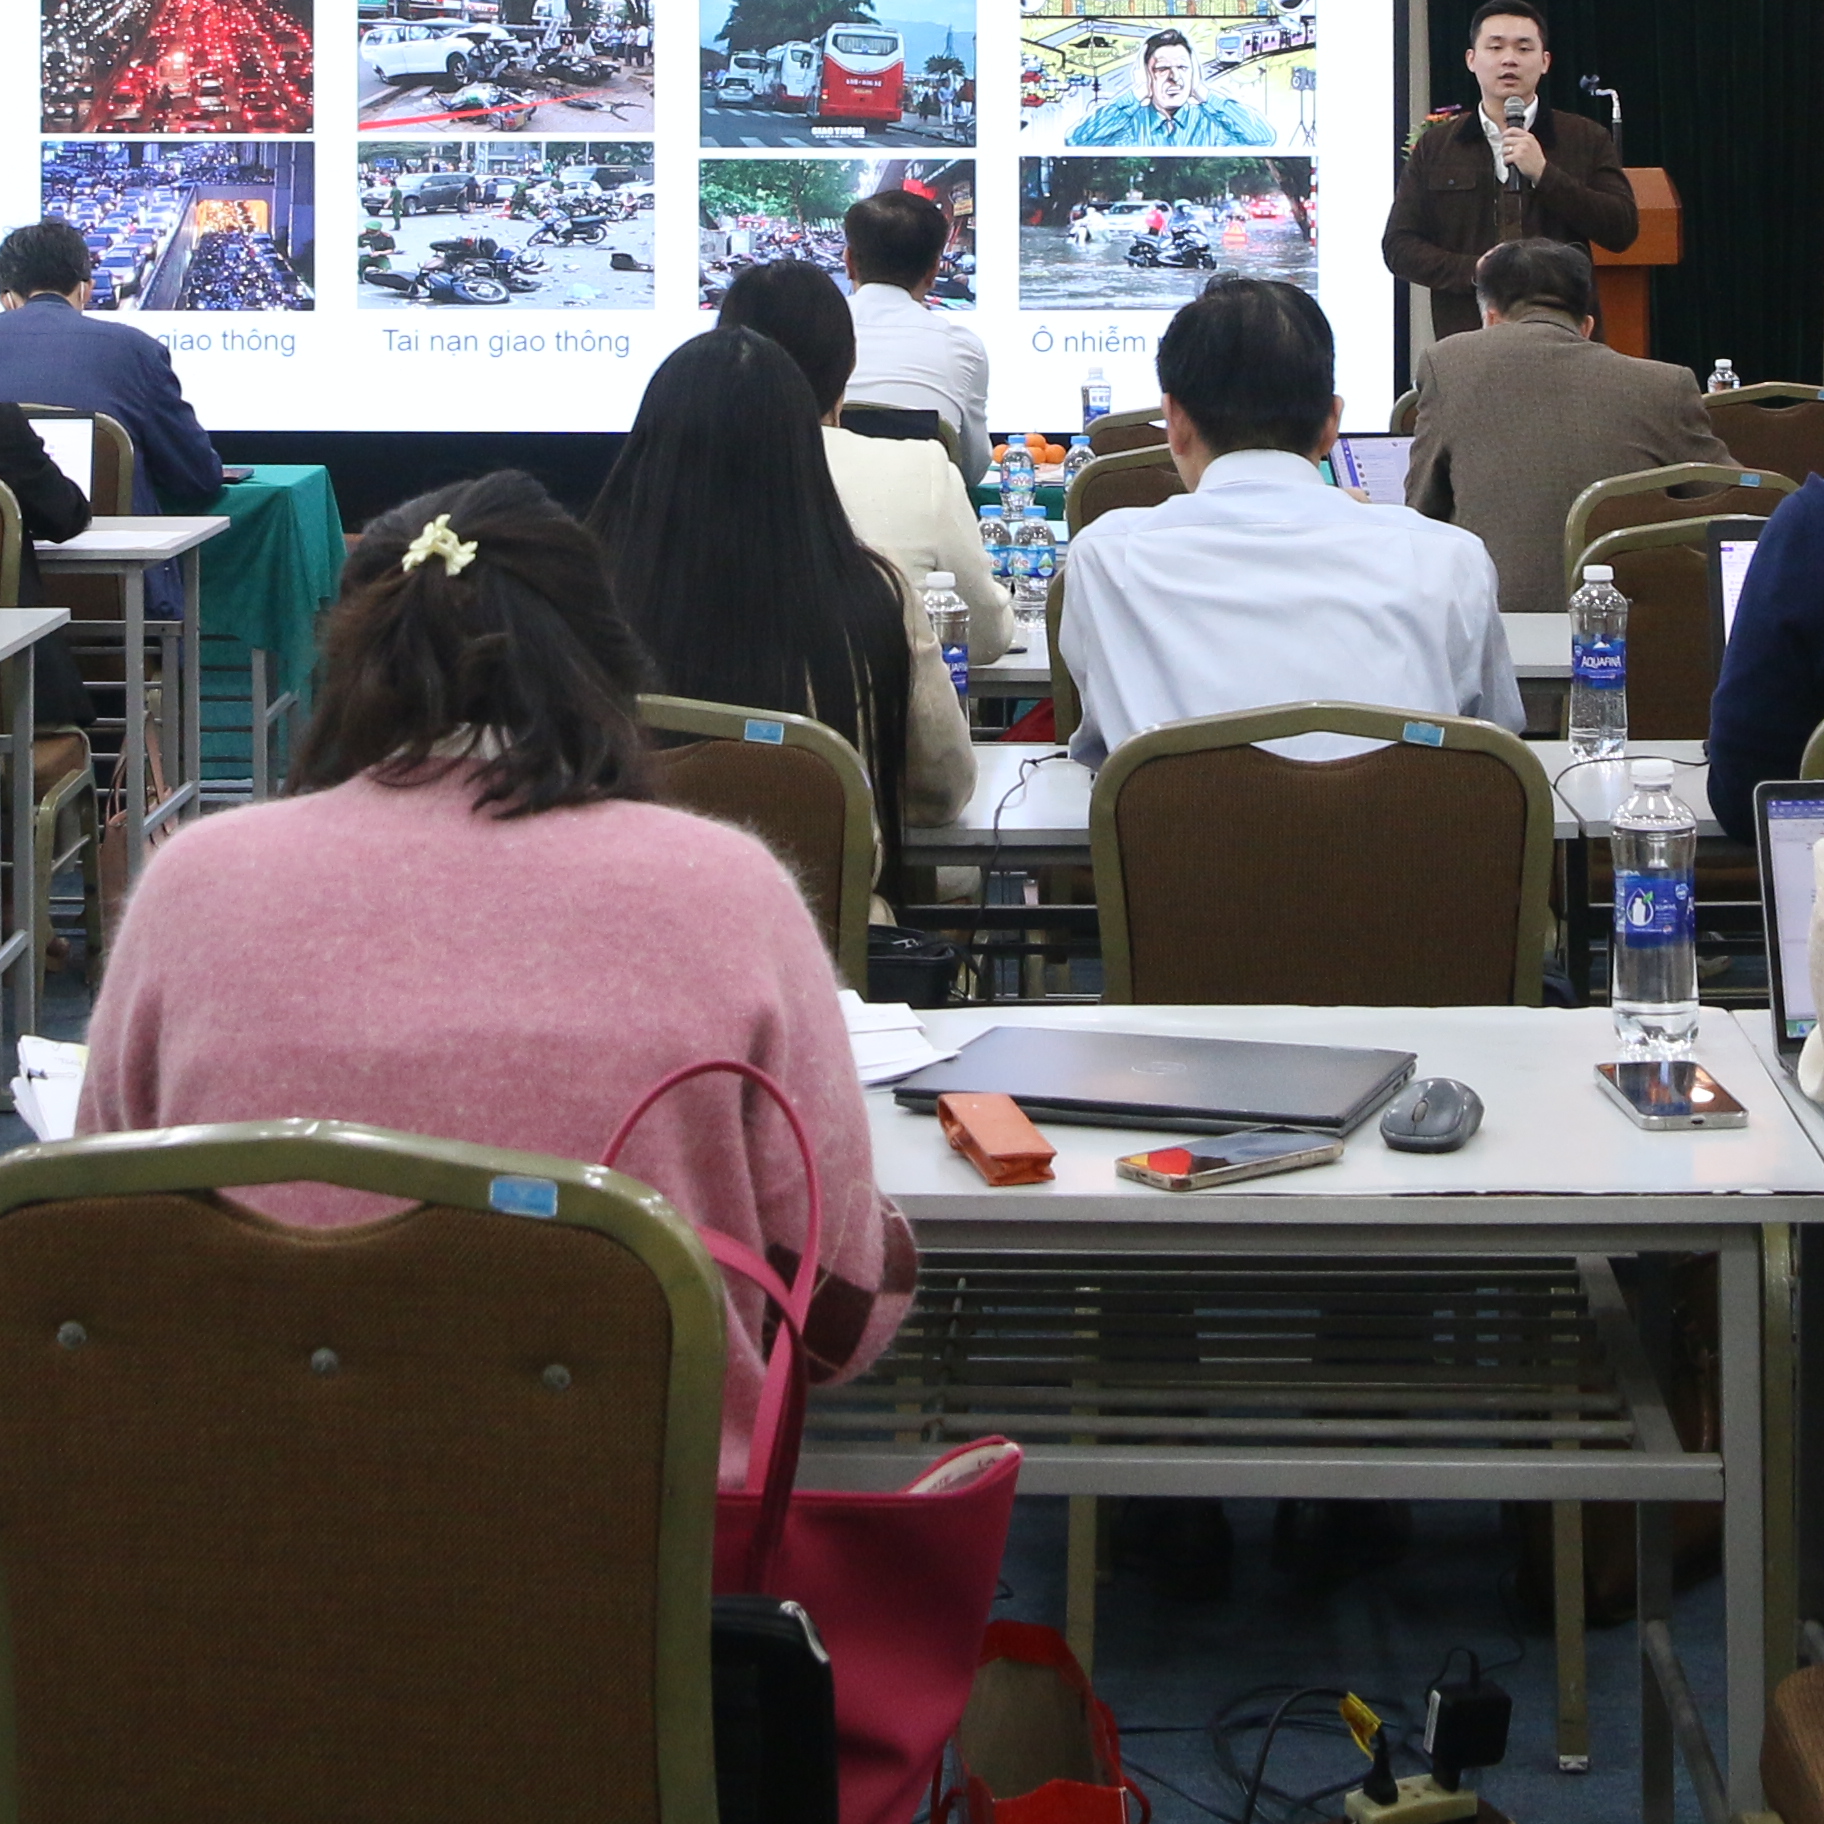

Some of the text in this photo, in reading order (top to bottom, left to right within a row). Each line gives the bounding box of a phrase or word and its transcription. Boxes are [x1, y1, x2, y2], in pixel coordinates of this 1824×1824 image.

[222, 328, 295, 357] thông
[383, 329, 629, 358] Tai nạn giao thông
[1032, 325, 1053, 352] Ô
[1065, 326, 1145, 352] nhiễm
